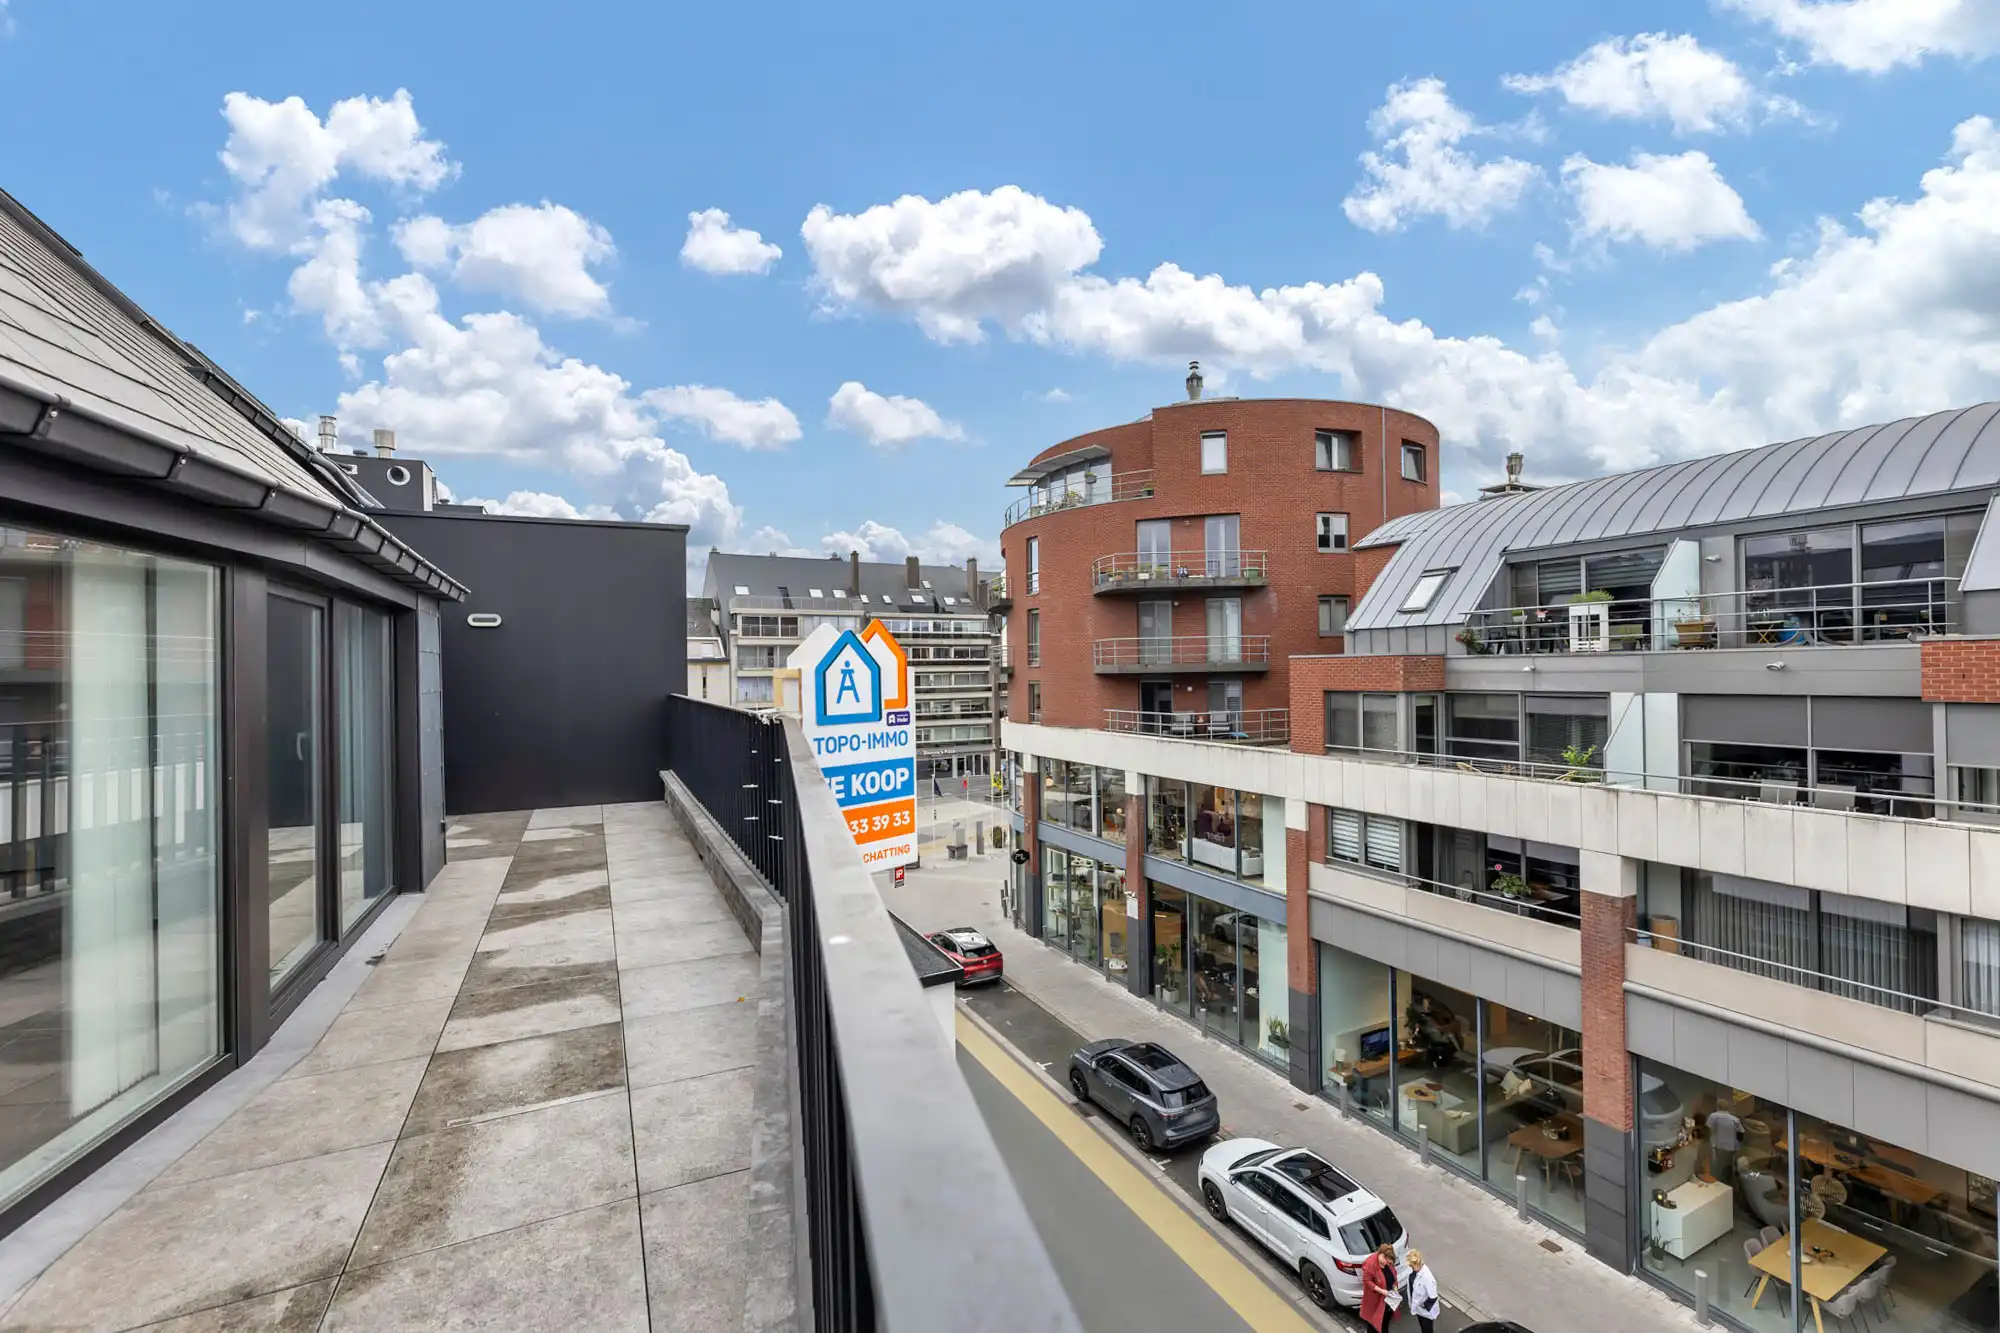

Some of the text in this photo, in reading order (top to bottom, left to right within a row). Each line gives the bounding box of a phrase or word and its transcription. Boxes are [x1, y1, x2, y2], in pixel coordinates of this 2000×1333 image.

[813, 730, 908, 755] TOPO-IMMO
[851, 767, 909, 797] KOOP
[849, 810, 911, 836] 33 39 33
[863, 843, 911, 864] CHATTING
